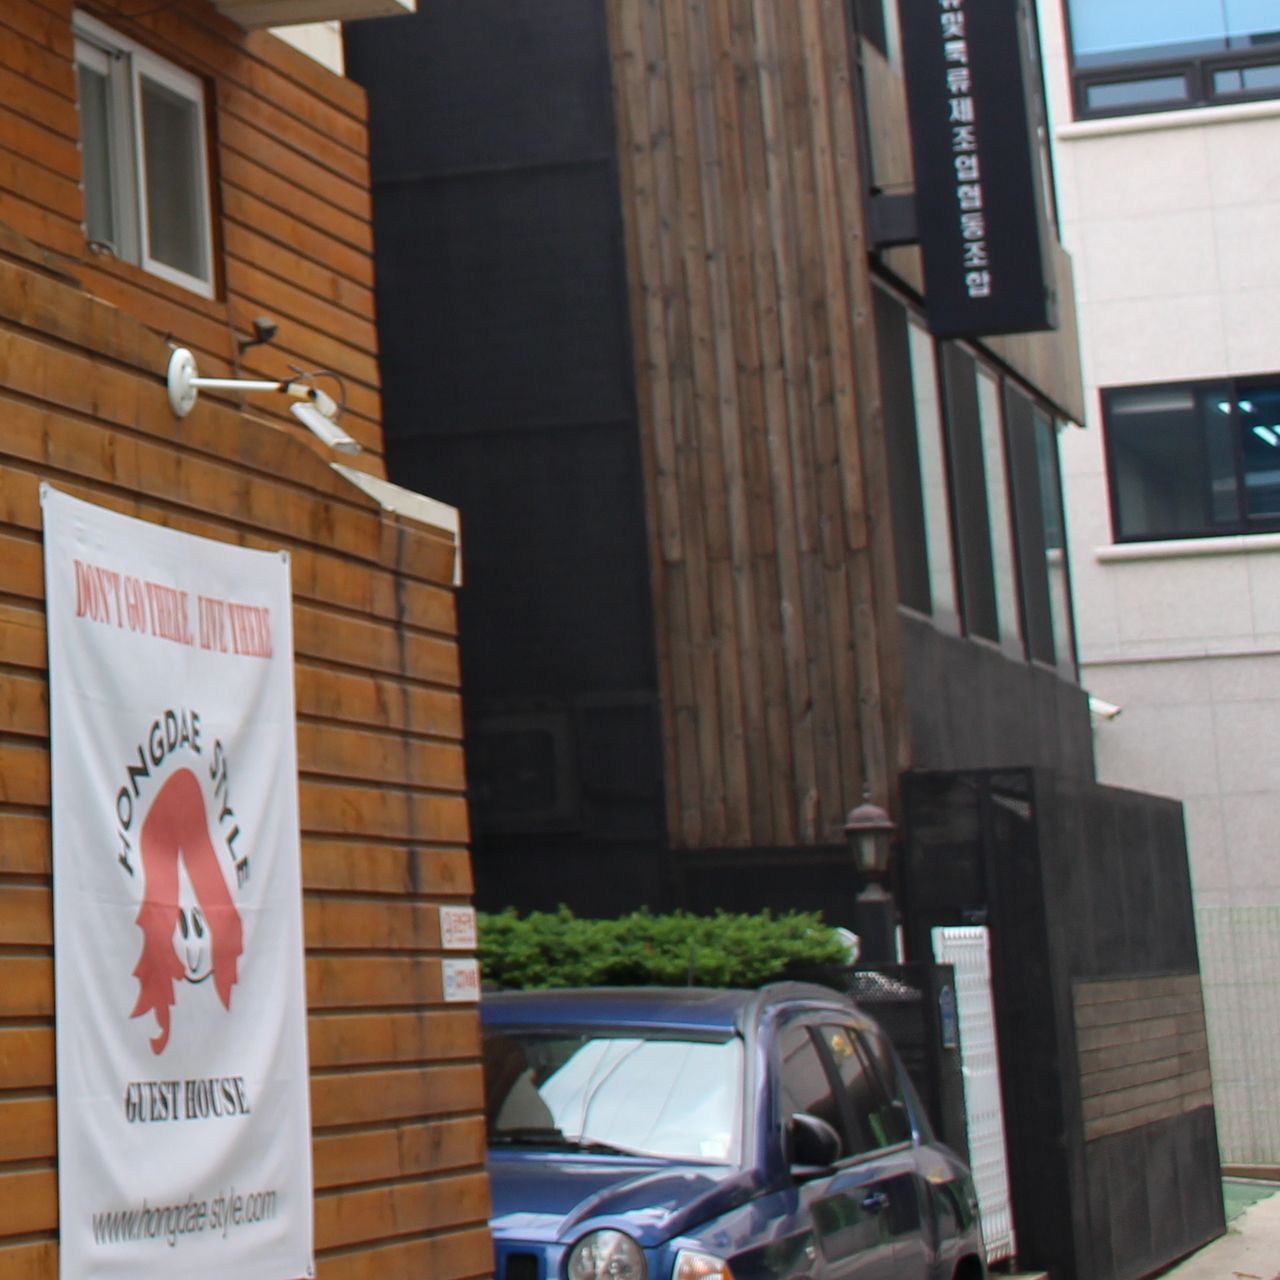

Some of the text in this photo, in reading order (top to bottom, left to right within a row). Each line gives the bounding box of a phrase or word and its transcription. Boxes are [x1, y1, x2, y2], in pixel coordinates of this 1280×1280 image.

[115, 705, 249, 890] HONGDAE STYLE
[125, 1076, 250, 1123] GUEST HOUSE
